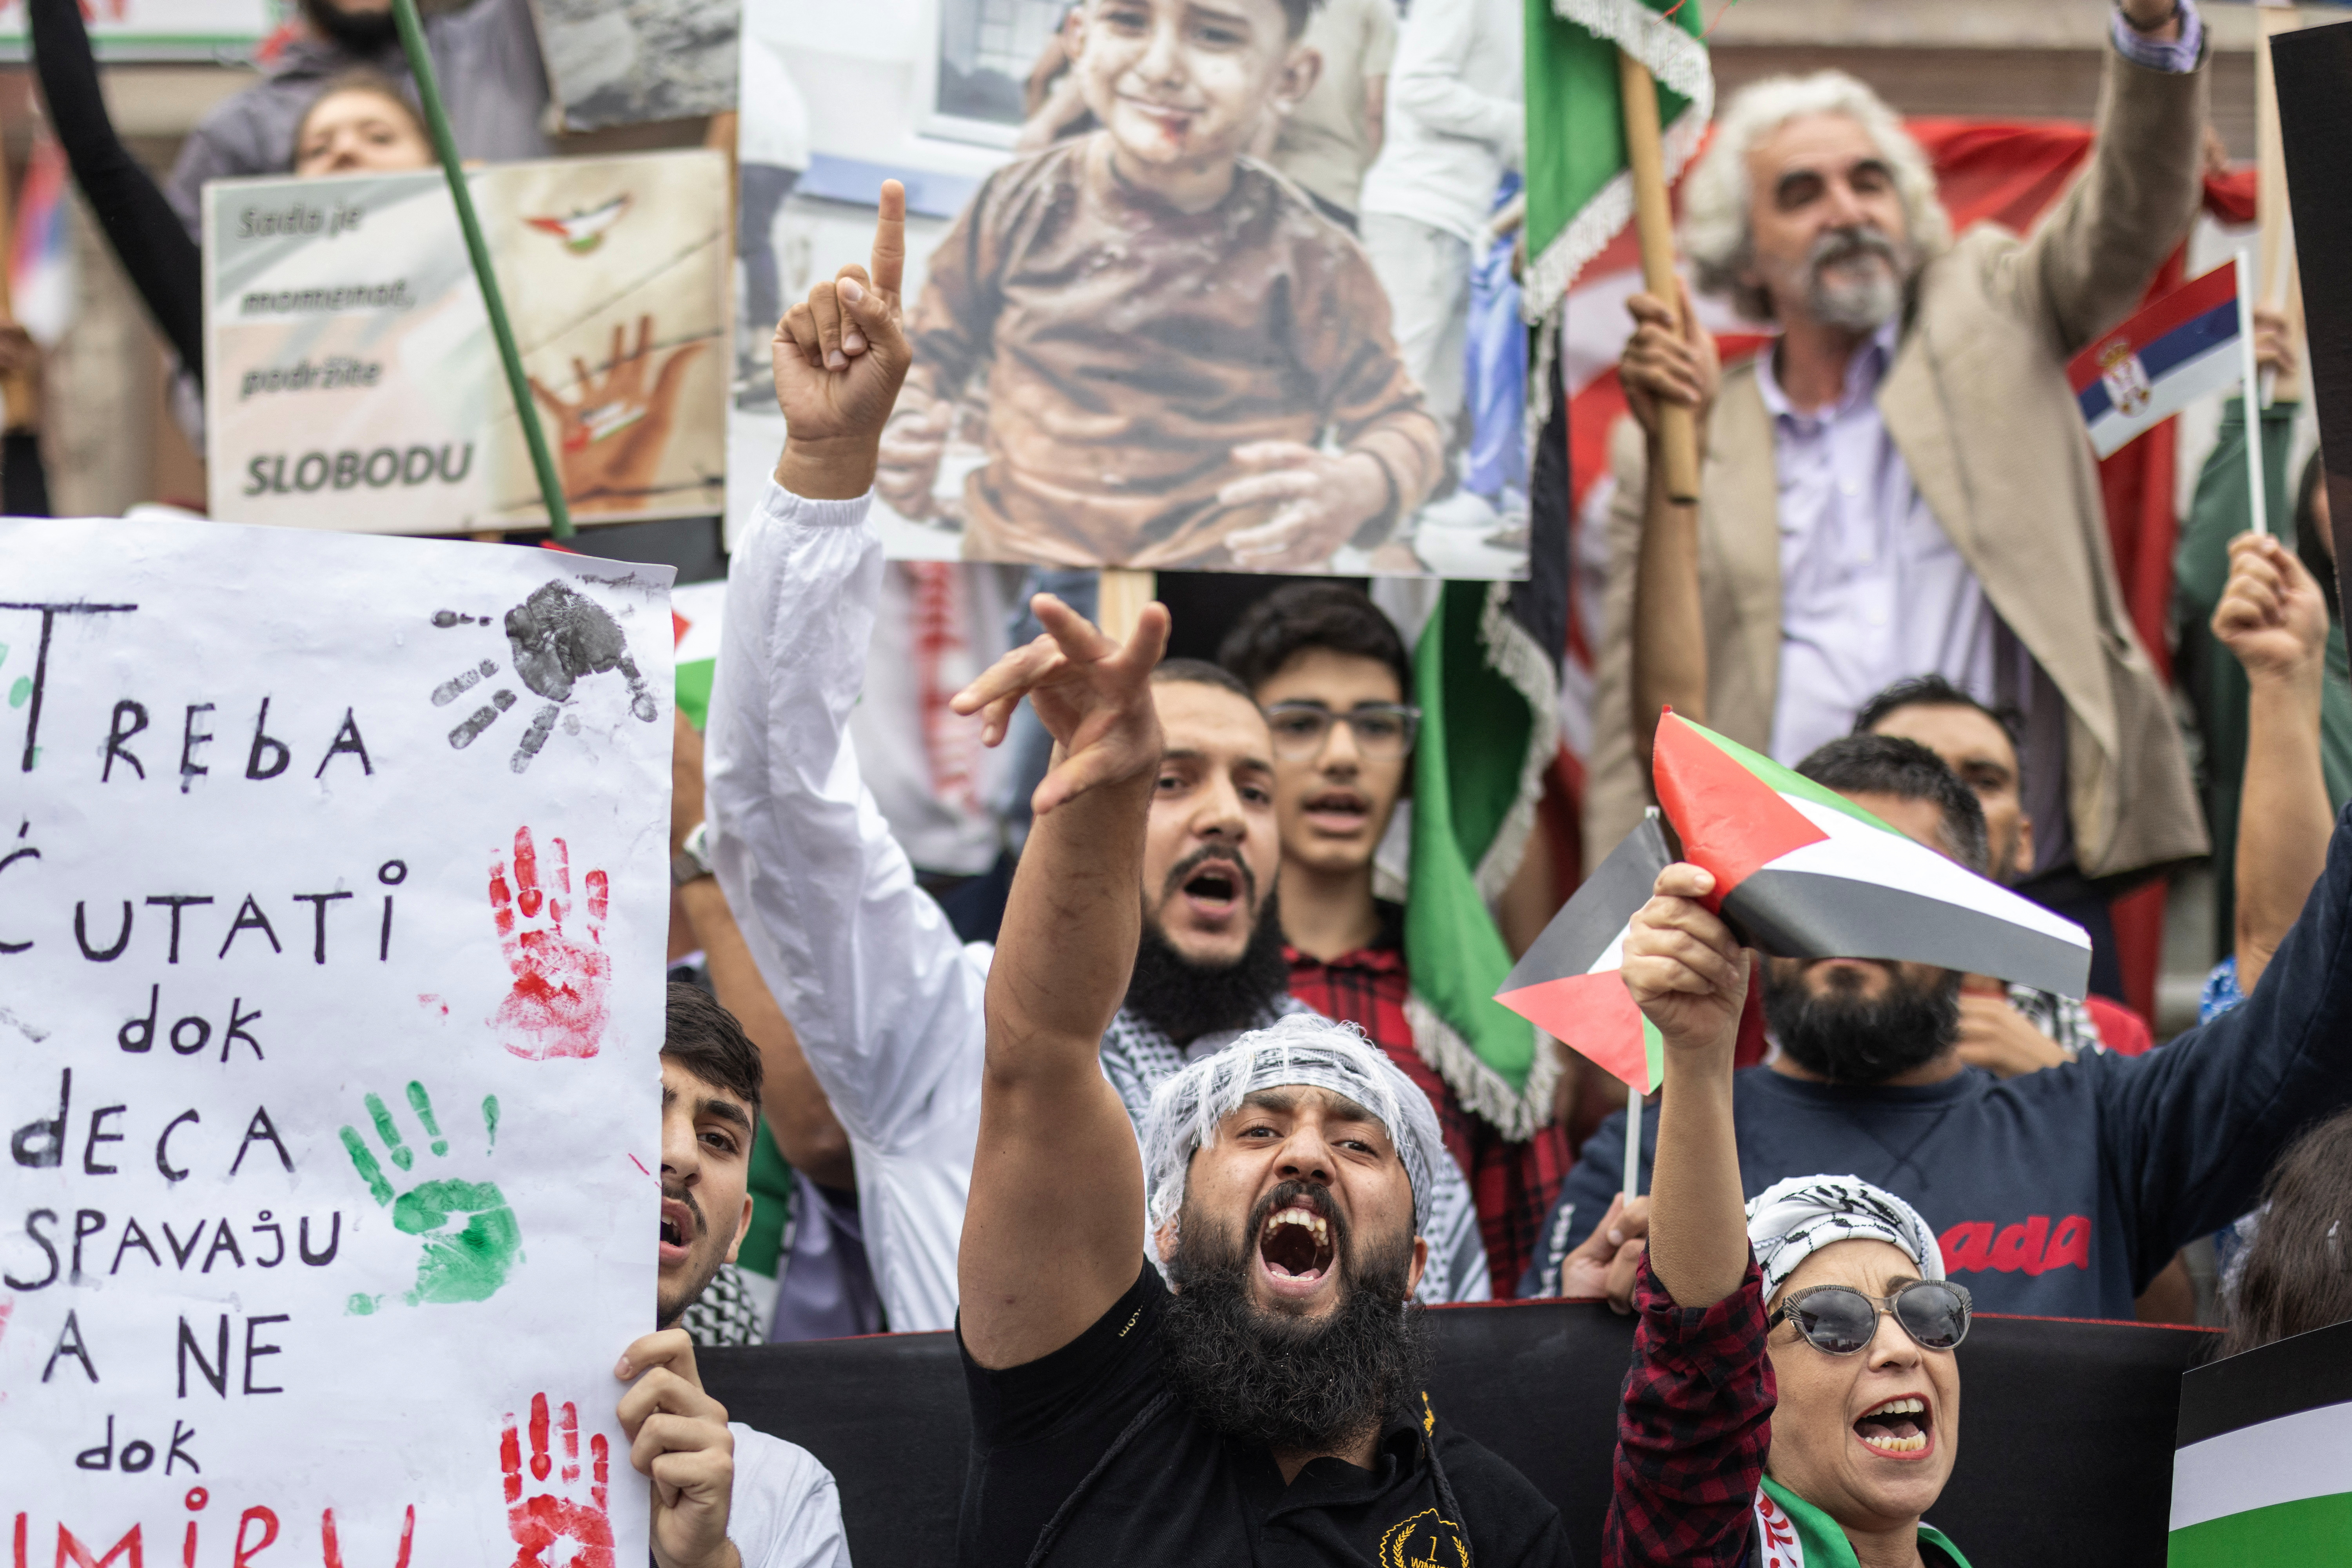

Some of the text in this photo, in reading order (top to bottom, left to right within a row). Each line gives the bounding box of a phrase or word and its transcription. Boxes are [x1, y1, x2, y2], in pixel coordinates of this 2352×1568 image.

[243, 441, 474, 495] SLOBODU
[43, 1309, 289, 1398] A NE
